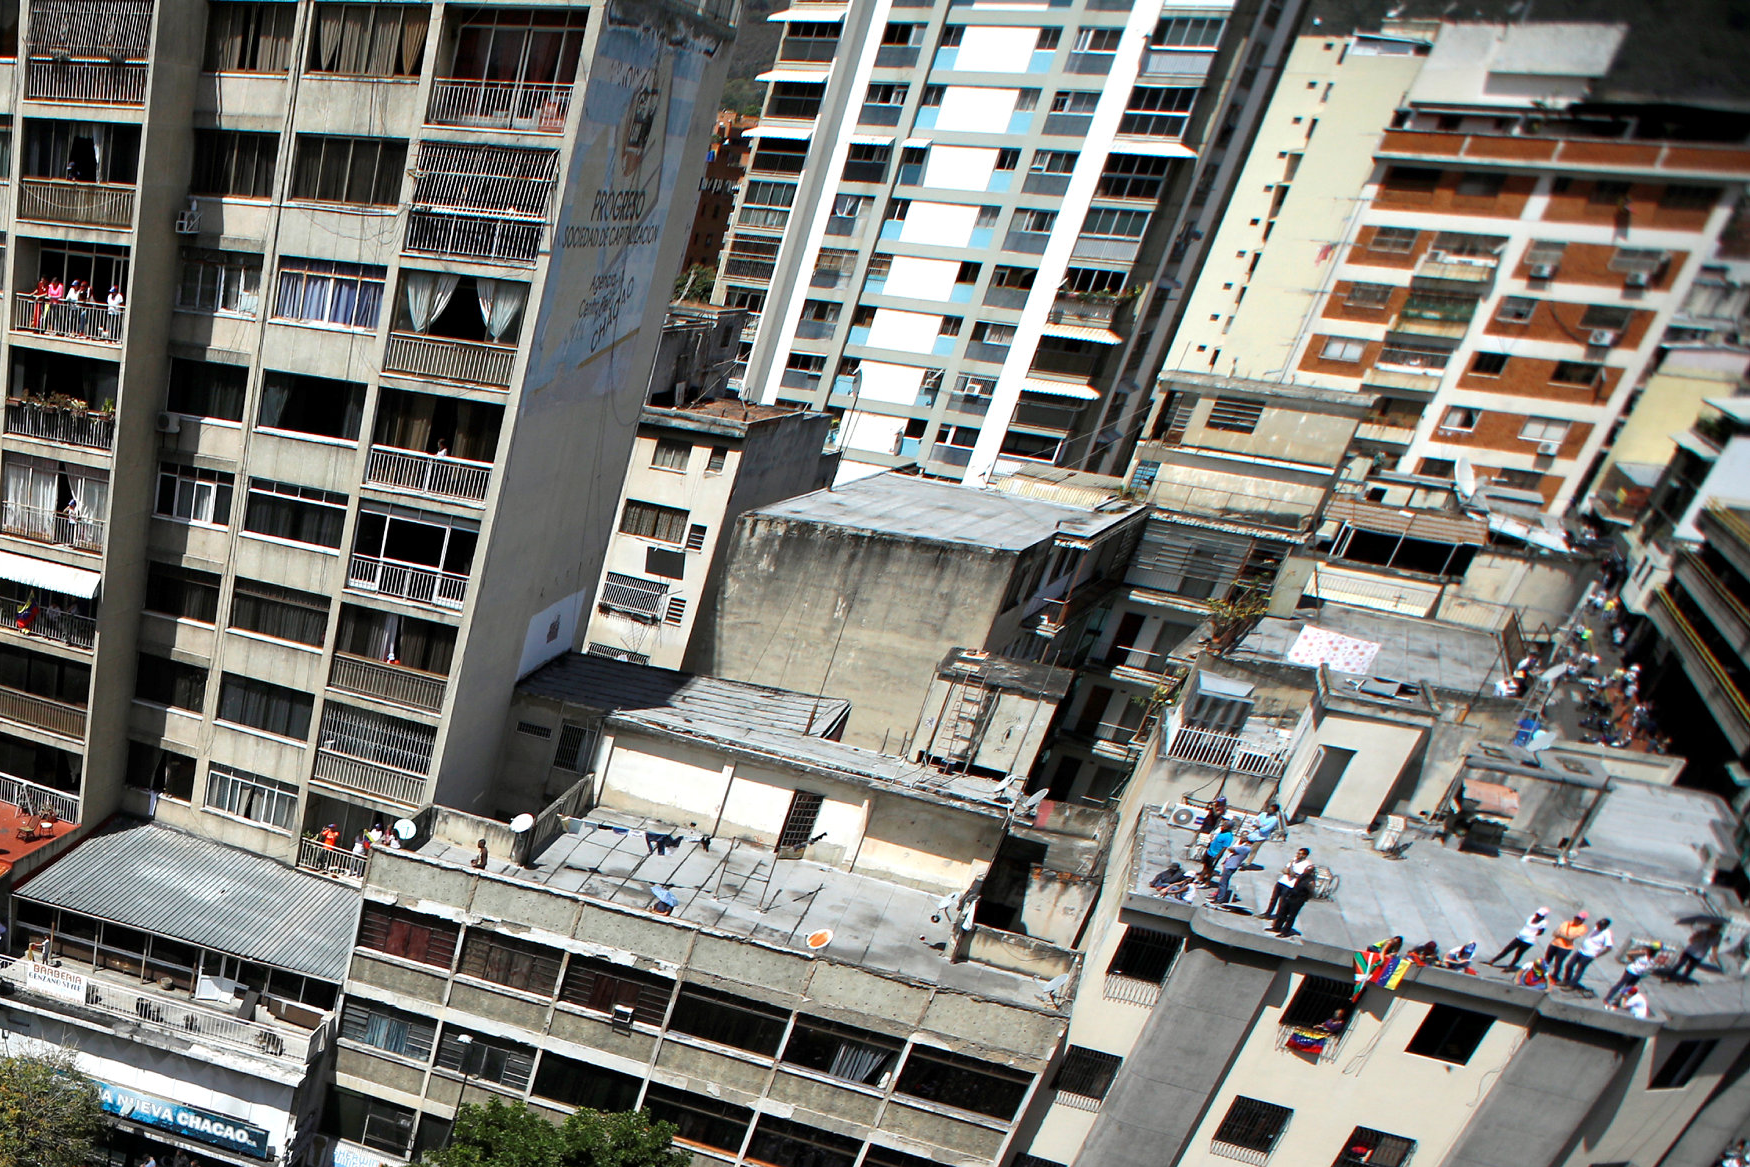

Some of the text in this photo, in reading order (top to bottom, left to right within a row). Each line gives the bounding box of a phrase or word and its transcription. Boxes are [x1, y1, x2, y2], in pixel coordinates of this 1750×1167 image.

[590, 190, 645, 221] PROGRESO
[562, 226, 599, 248] SOCIEDAD
[600, 227, 609, 247] DE
[591, 276, 634, 353] CHACAO
[33, 964, 82, 985] BARBERIA
[176, 1112, 249, 1144] CHACAO
